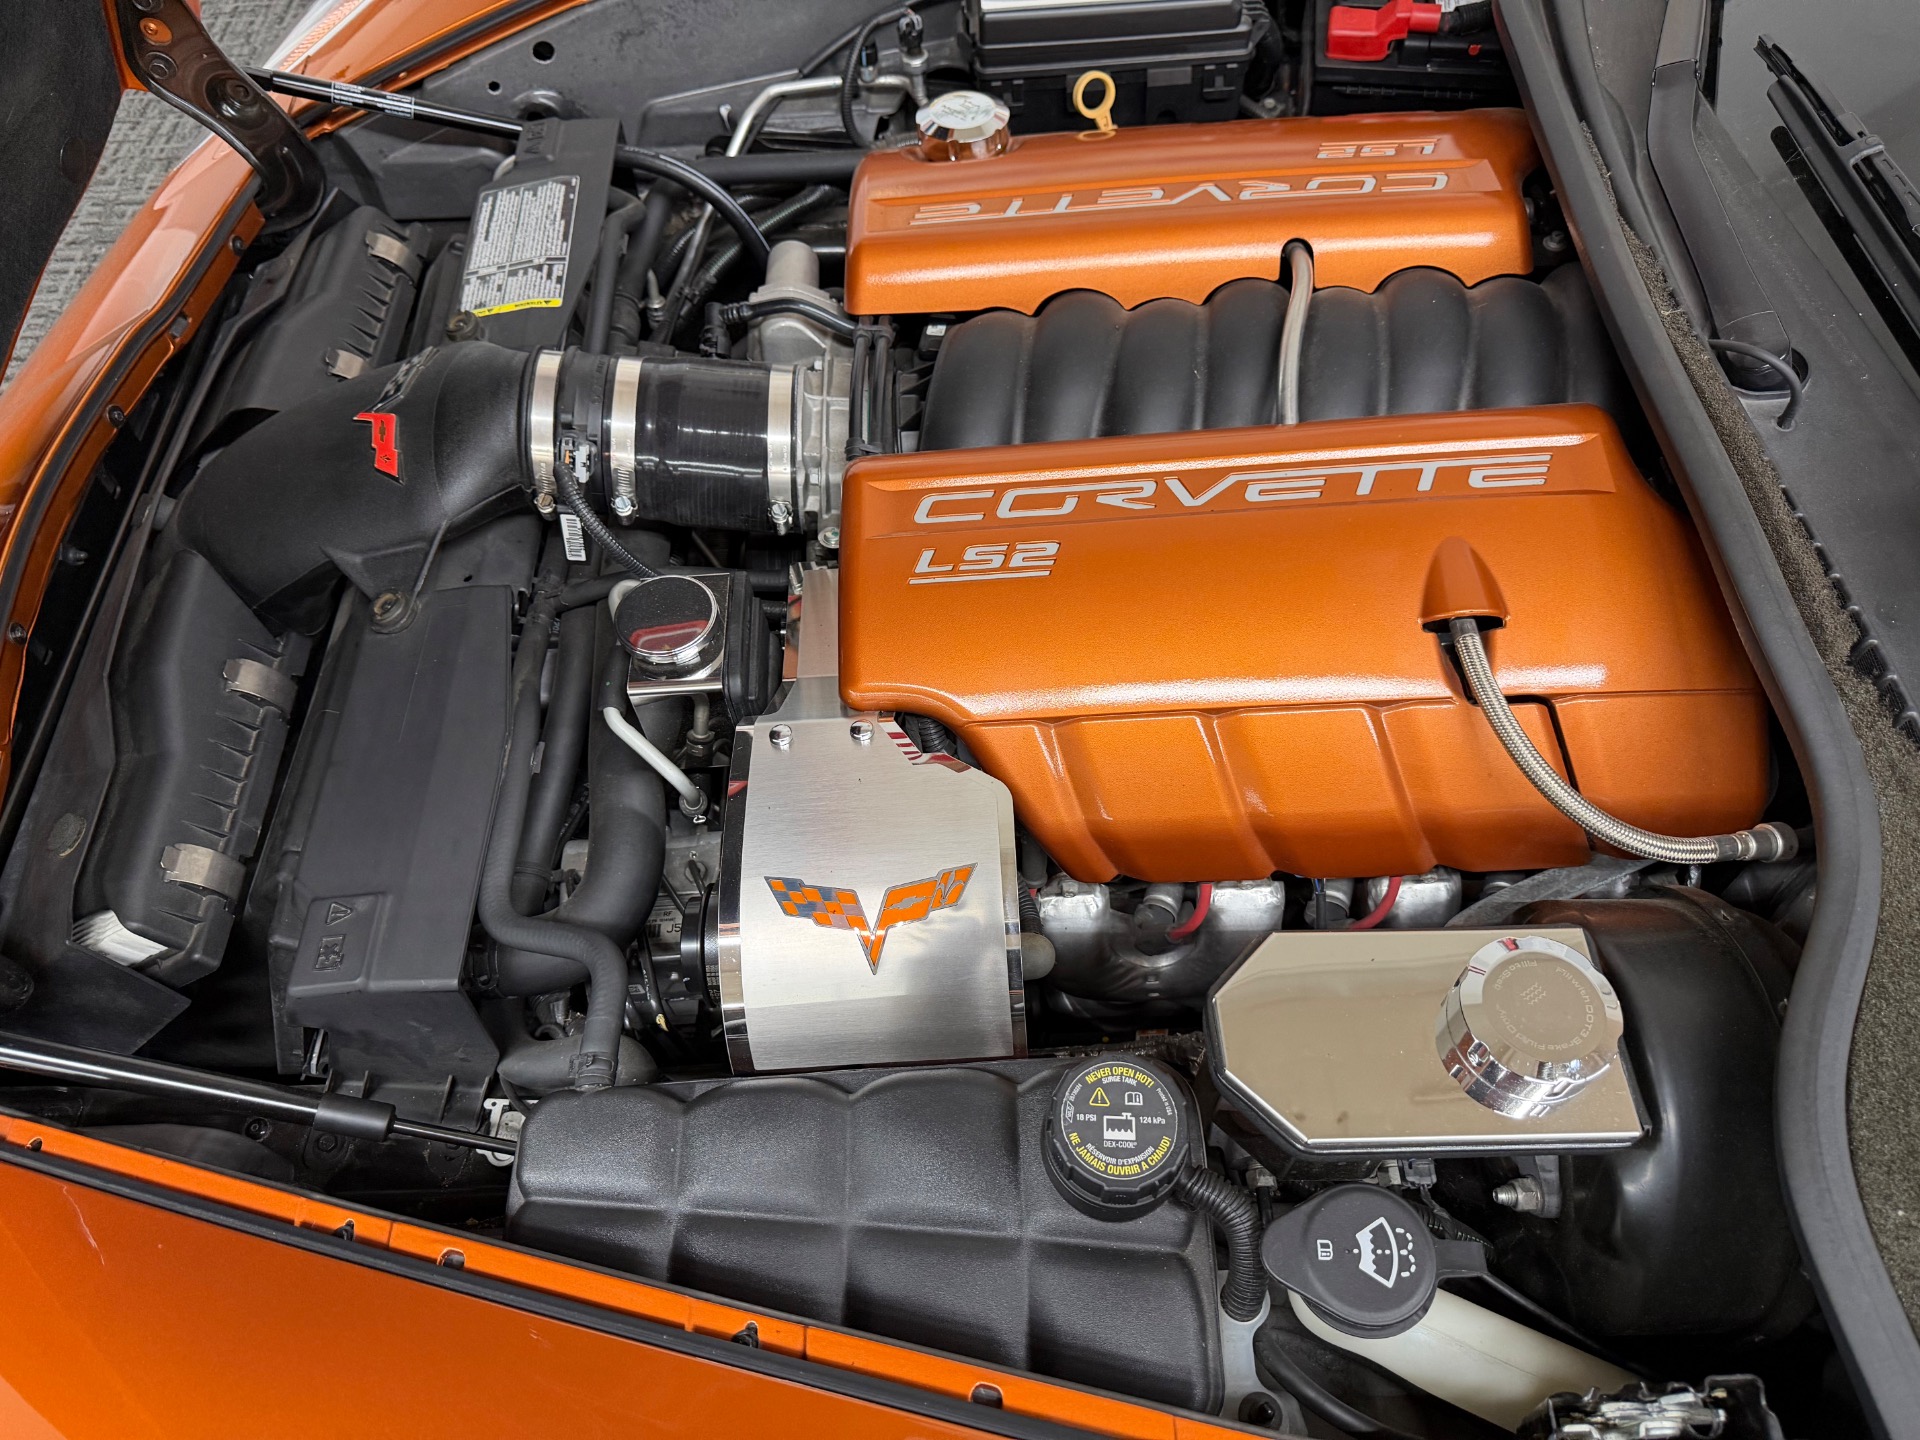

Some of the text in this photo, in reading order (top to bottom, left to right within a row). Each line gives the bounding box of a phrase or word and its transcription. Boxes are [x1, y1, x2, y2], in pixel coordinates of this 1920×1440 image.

[1316, 139, 1440, 160] LS2
[909, 171, 1449, 225] CORVETTE
[913, 453, 1553, 524] CORVETTE
[914, 541, 1061, 575] LS2
[1521, 960, 1538, 968] Fill
[1516, 1032, 1546, 1051] Fluid
[1547, 1037, 1582, 1052] Brake
[1085, 1067, 1155, 1088] NEVER OPEN HOT!
[1102, 1076, 1138, 1086] SURGE TANK
[1076, 1113, 1097, 1122] 18 PSI
[1139, 1116, 1151, 1124] 124
[1069, 1132, 1081, 1146] NE
[1076, 1143, 1106, 1171] JAMAIS
[1107, 1164, 1141, 1176] OUVRIR
[1147, 1135, 1172, 1166] CHAUD!
[1085, 1142, 1155, 1165] RÉSERVOIR D'EXPANSION
